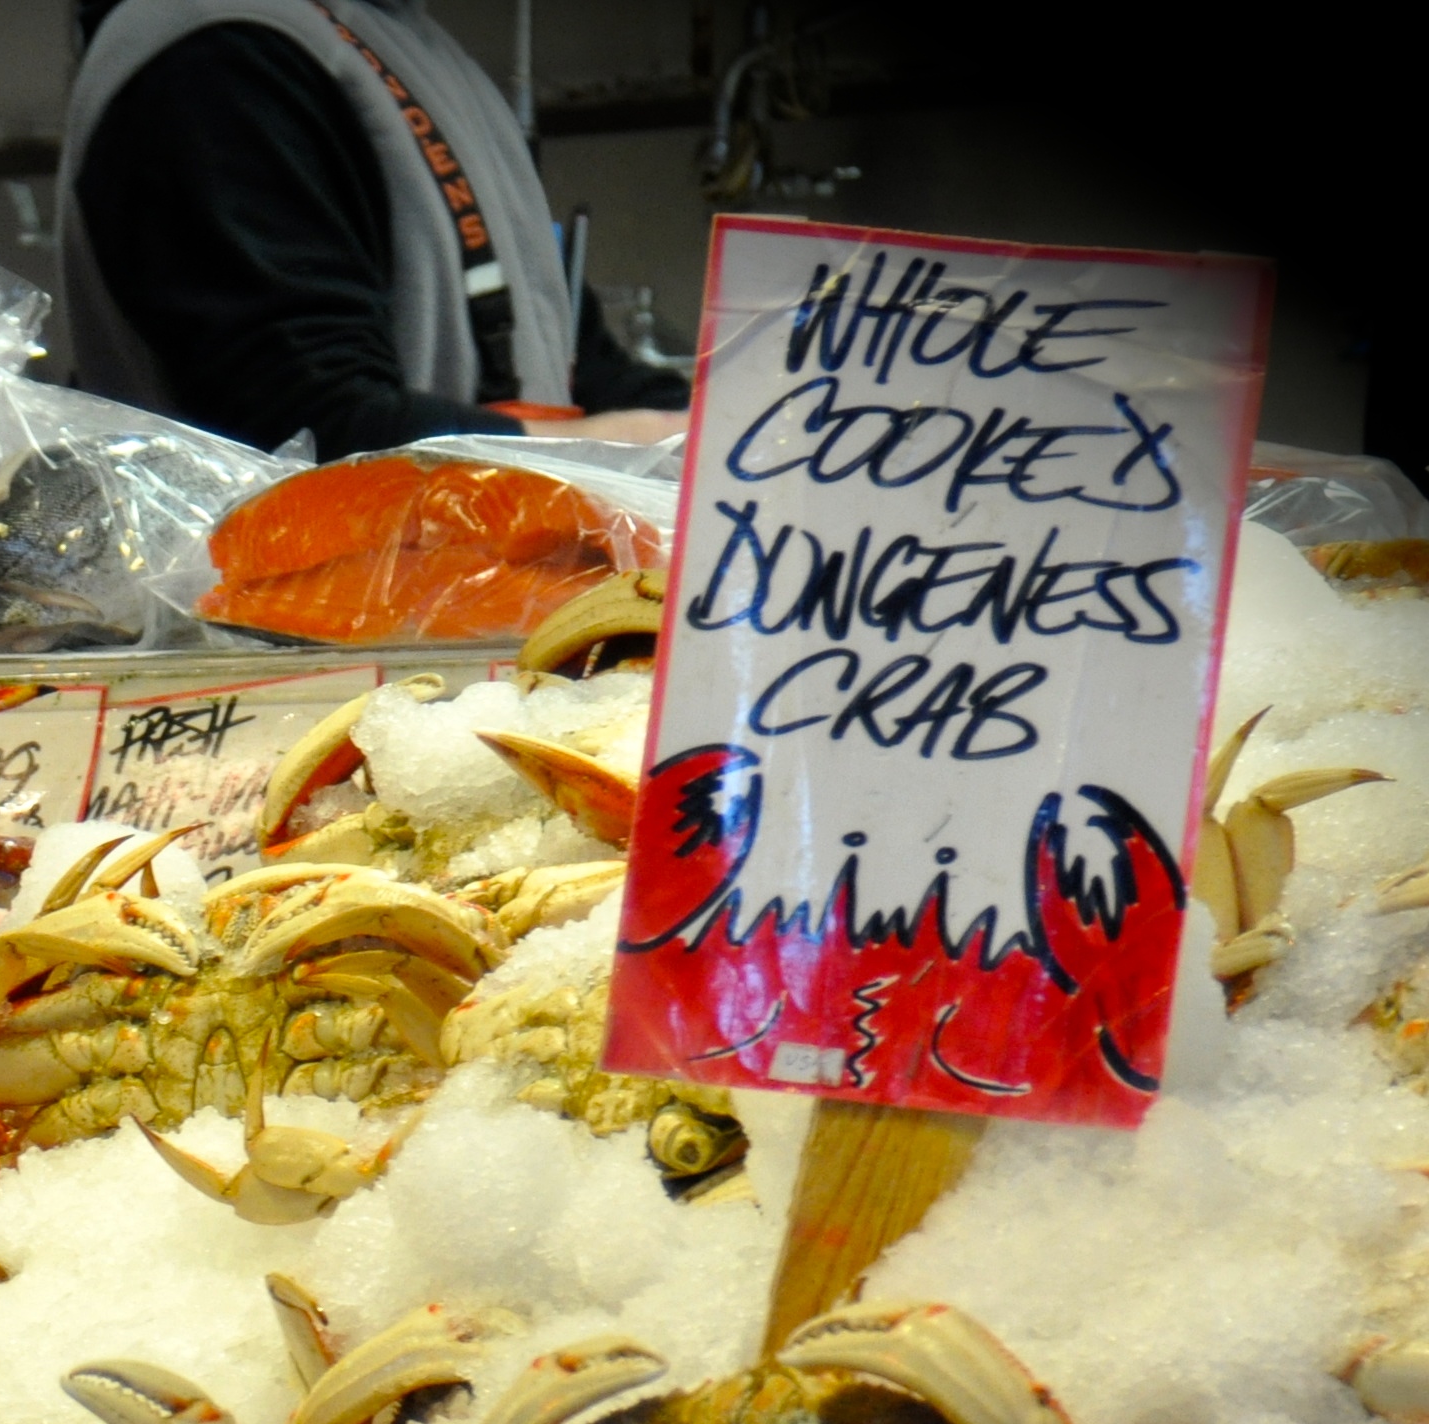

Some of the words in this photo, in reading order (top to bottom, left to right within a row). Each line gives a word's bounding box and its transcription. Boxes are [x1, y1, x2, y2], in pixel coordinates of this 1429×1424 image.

[786, 251, 1168, 380] WHOLE
[727, 375, 1182, 513] COOKED
[686, 501, 1201, 645] DUNGENESS
[748, 648, 1051, 762] CRAB
